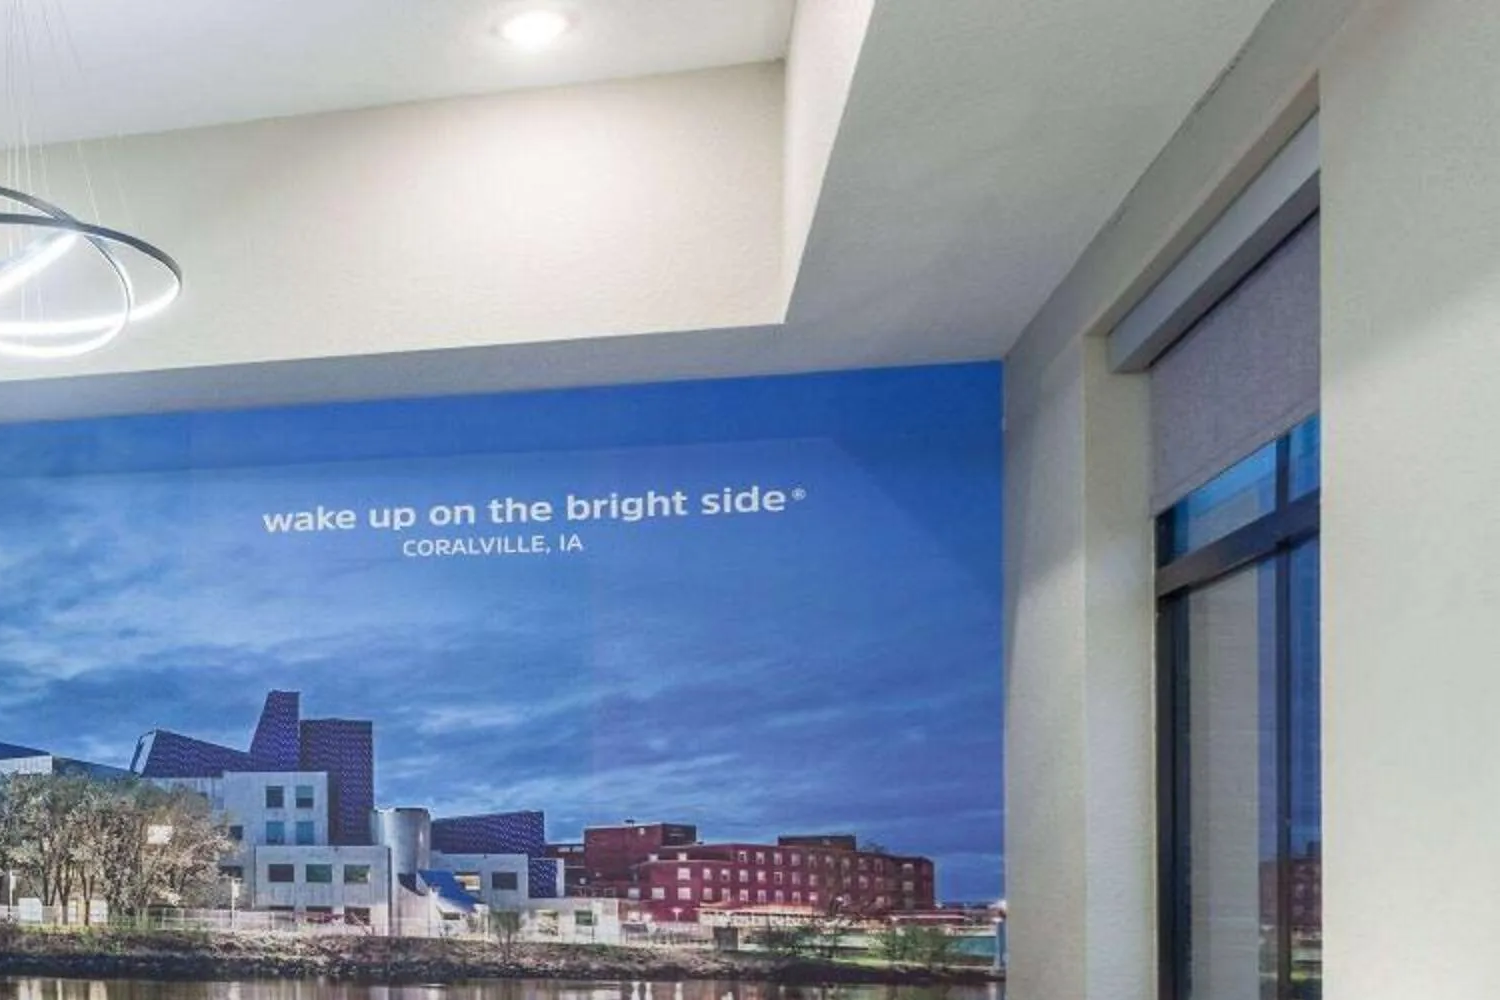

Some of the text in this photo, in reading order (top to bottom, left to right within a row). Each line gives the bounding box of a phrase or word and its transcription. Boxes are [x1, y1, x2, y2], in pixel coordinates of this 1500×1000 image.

[263, 506, 357, 533] wake
[368, 507, 417, 532] up
[429, 504, 475, 526] on
[487, 497, 553, 524] the
[566, 490, 688, 522] bright
[403, 533, 584, 557] CORALVILLE, IA
